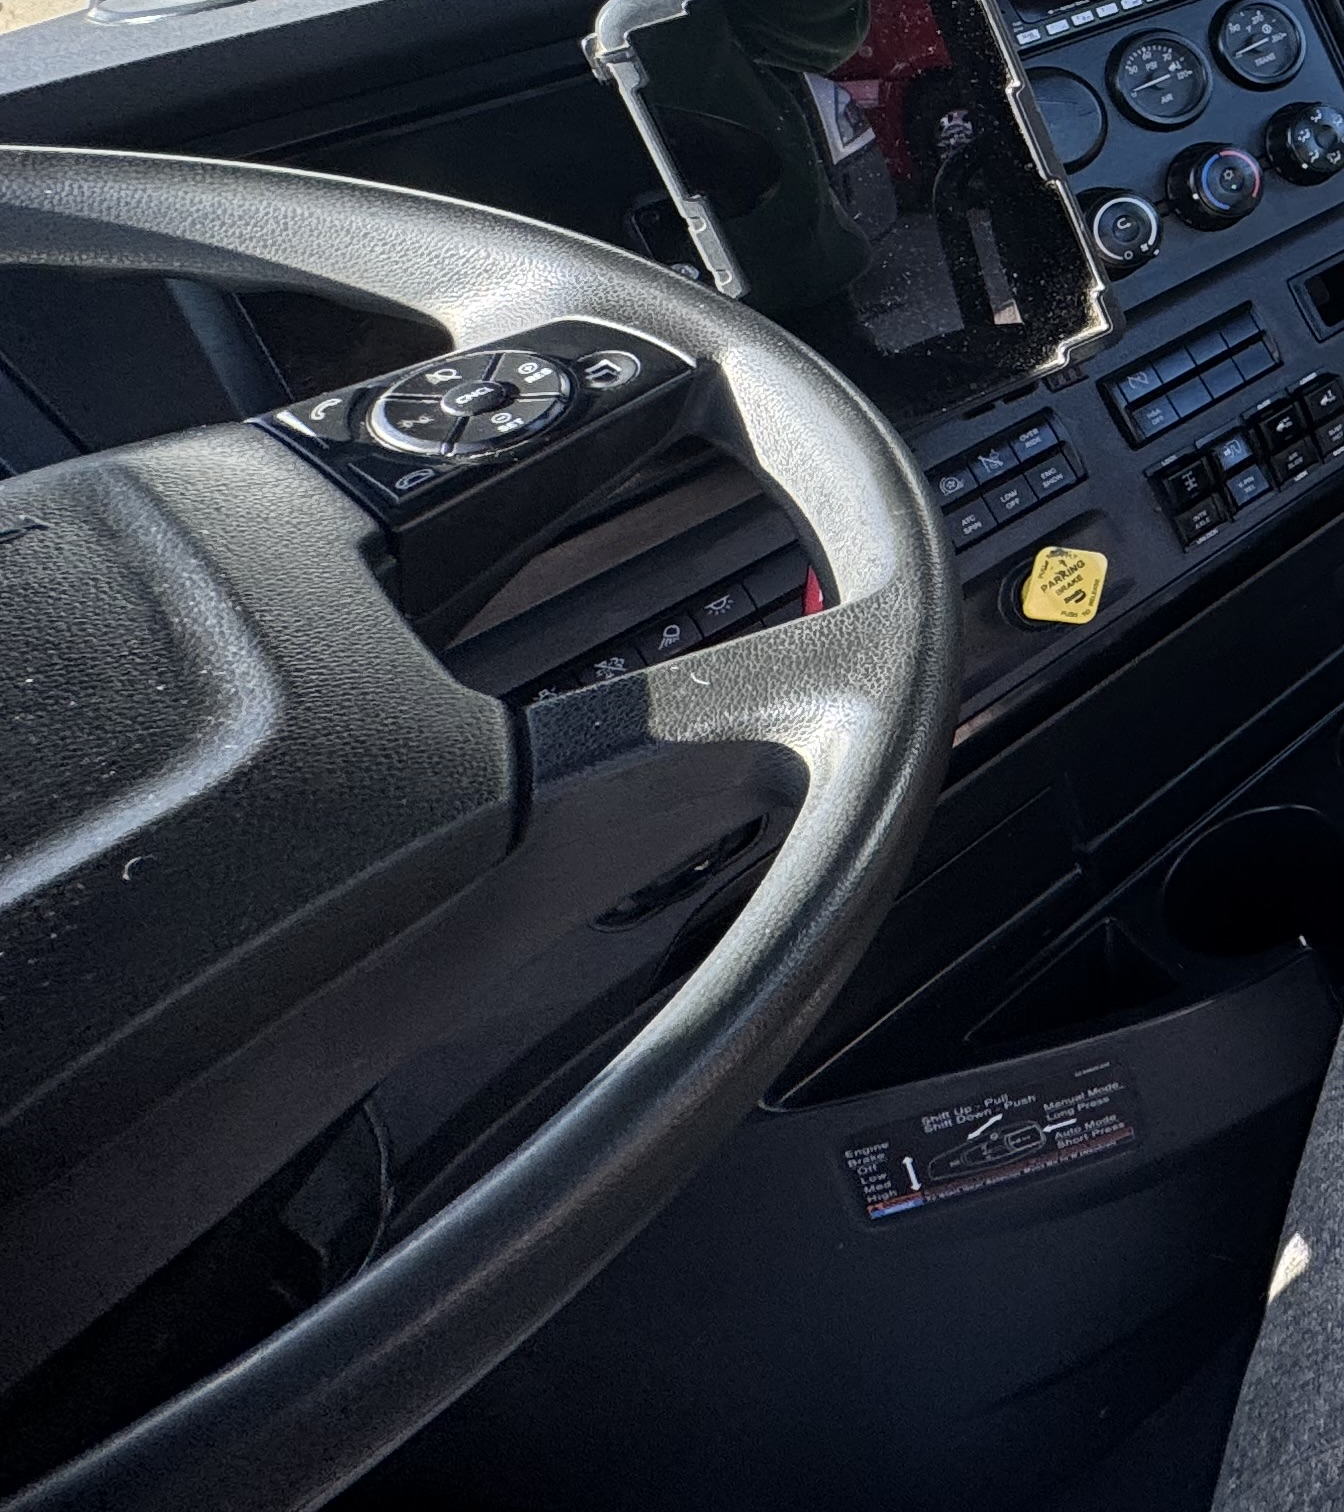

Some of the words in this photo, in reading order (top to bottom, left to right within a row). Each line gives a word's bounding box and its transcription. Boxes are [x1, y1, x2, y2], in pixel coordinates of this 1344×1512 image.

[1019, 428, 1040, 442] OVER
[1025, 436, 1043, 449] RIDE
[961, 514, 976, 526] ATC
[1040, 560, 1085, 593] PARKING
[1056, 574, 1084, 596] BRAKE
[954, 1106, 973, 1116] Up
[984, 1093, 1009, 1107] Pull
[956, 1108, 992, 1124] Down
[1004, 1095, 1037, 1110] Push
[1043, 1092, 1085, 1111] Manual
[1046, 1108, 1075, 1121] Long
[1077, 1096, 1110, 1111] Press
[1055, 1126, 1082, 1140] Auto
[1057, 1133, 1089, 1149] Short
[1091, 1122, 1125, 1137] Press
[845, 1141, 889, 1158] Engine
[847, 1153, 886, 1168] Brake
[860, 1172, 887, 1185] Low
[864, 1180, 892, 1194] Med
[867, 1190, 898, 1203] High
